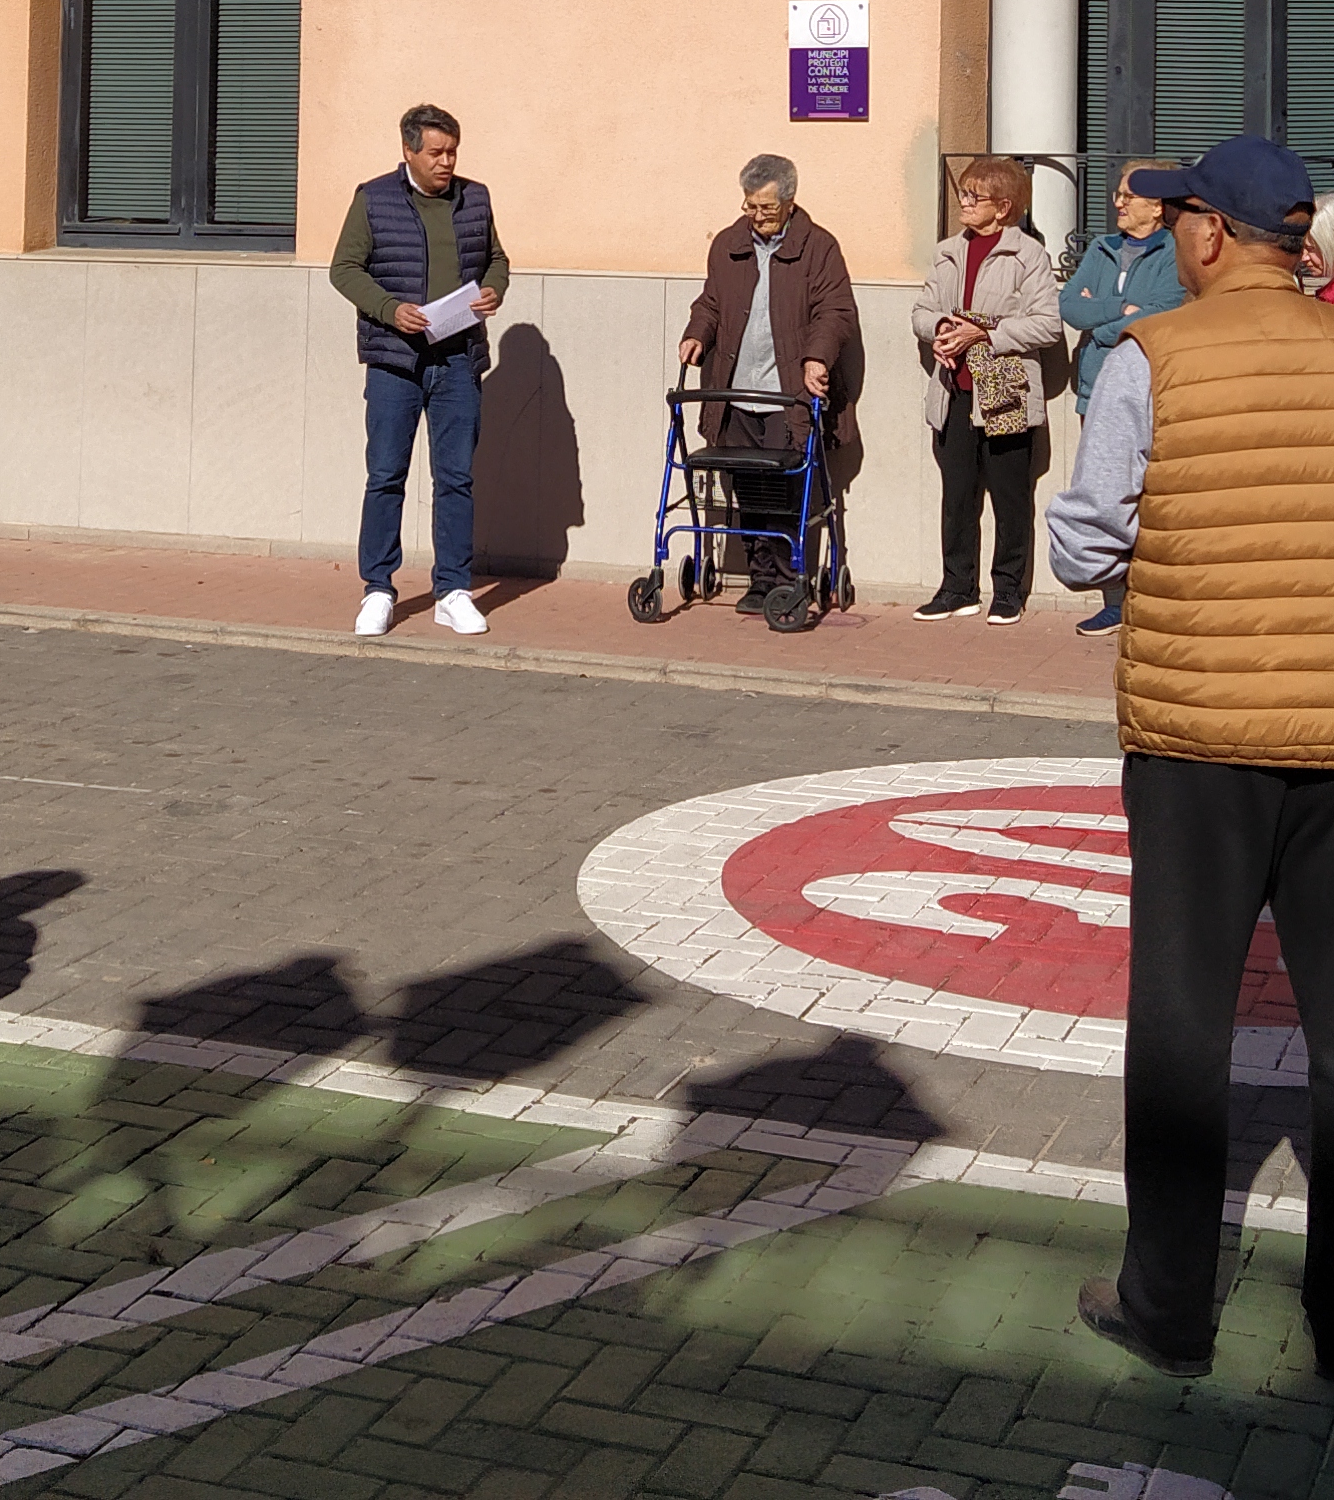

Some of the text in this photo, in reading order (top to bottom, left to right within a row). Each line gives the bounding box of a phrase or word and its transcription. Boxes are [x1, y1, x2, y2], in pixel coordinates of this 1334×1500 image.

[808, 50, 849, 58] MUNICIPI
[808, 59, 849, 67] PROTEGIT
[808, 67, 849, 76] CONTRA
